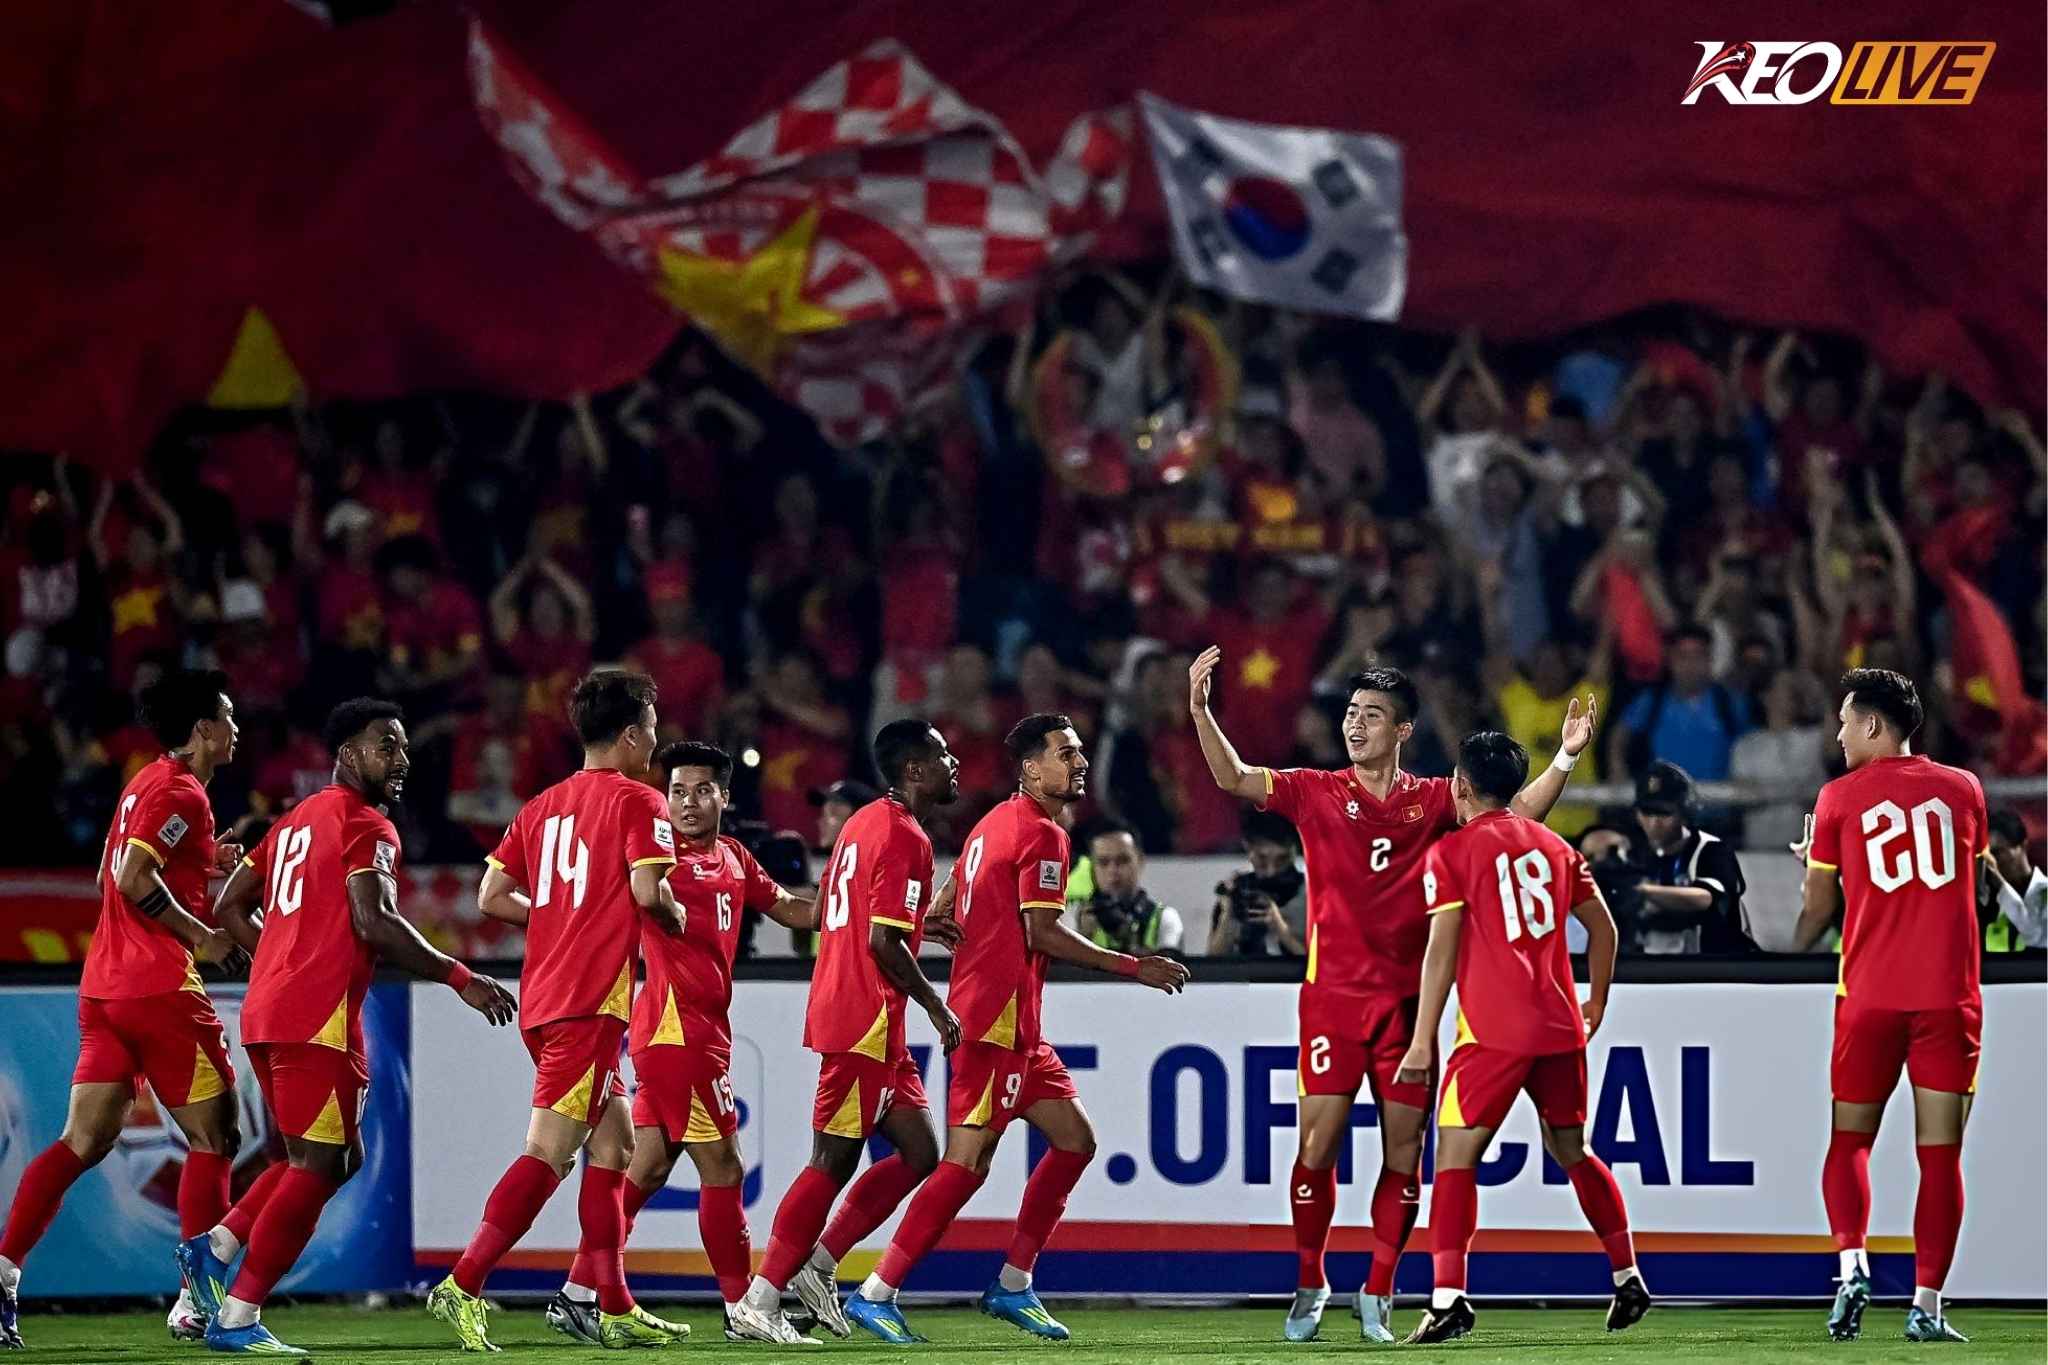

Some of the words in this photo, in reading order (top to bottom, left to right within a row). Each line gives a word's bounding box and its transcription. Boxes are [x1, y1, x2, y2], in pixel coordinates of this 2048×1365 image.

[268, 824, 312, 917] 12
[535, 814, 590, 910] 14
[825, 836, 858, 932] 13
[962, 834, 984, 919] 9
[1369, 837, 1392, 873] 2
[1861, 797, 1955, 893] 20
[715, 892, 732, 932] 15
[1496, 848, 1556, 943] 18
[711, 1071, 735, 1117] 15
[1001, 1073, 1022, 1110] 9
[1310, 1035, 1331, 1075] 2
